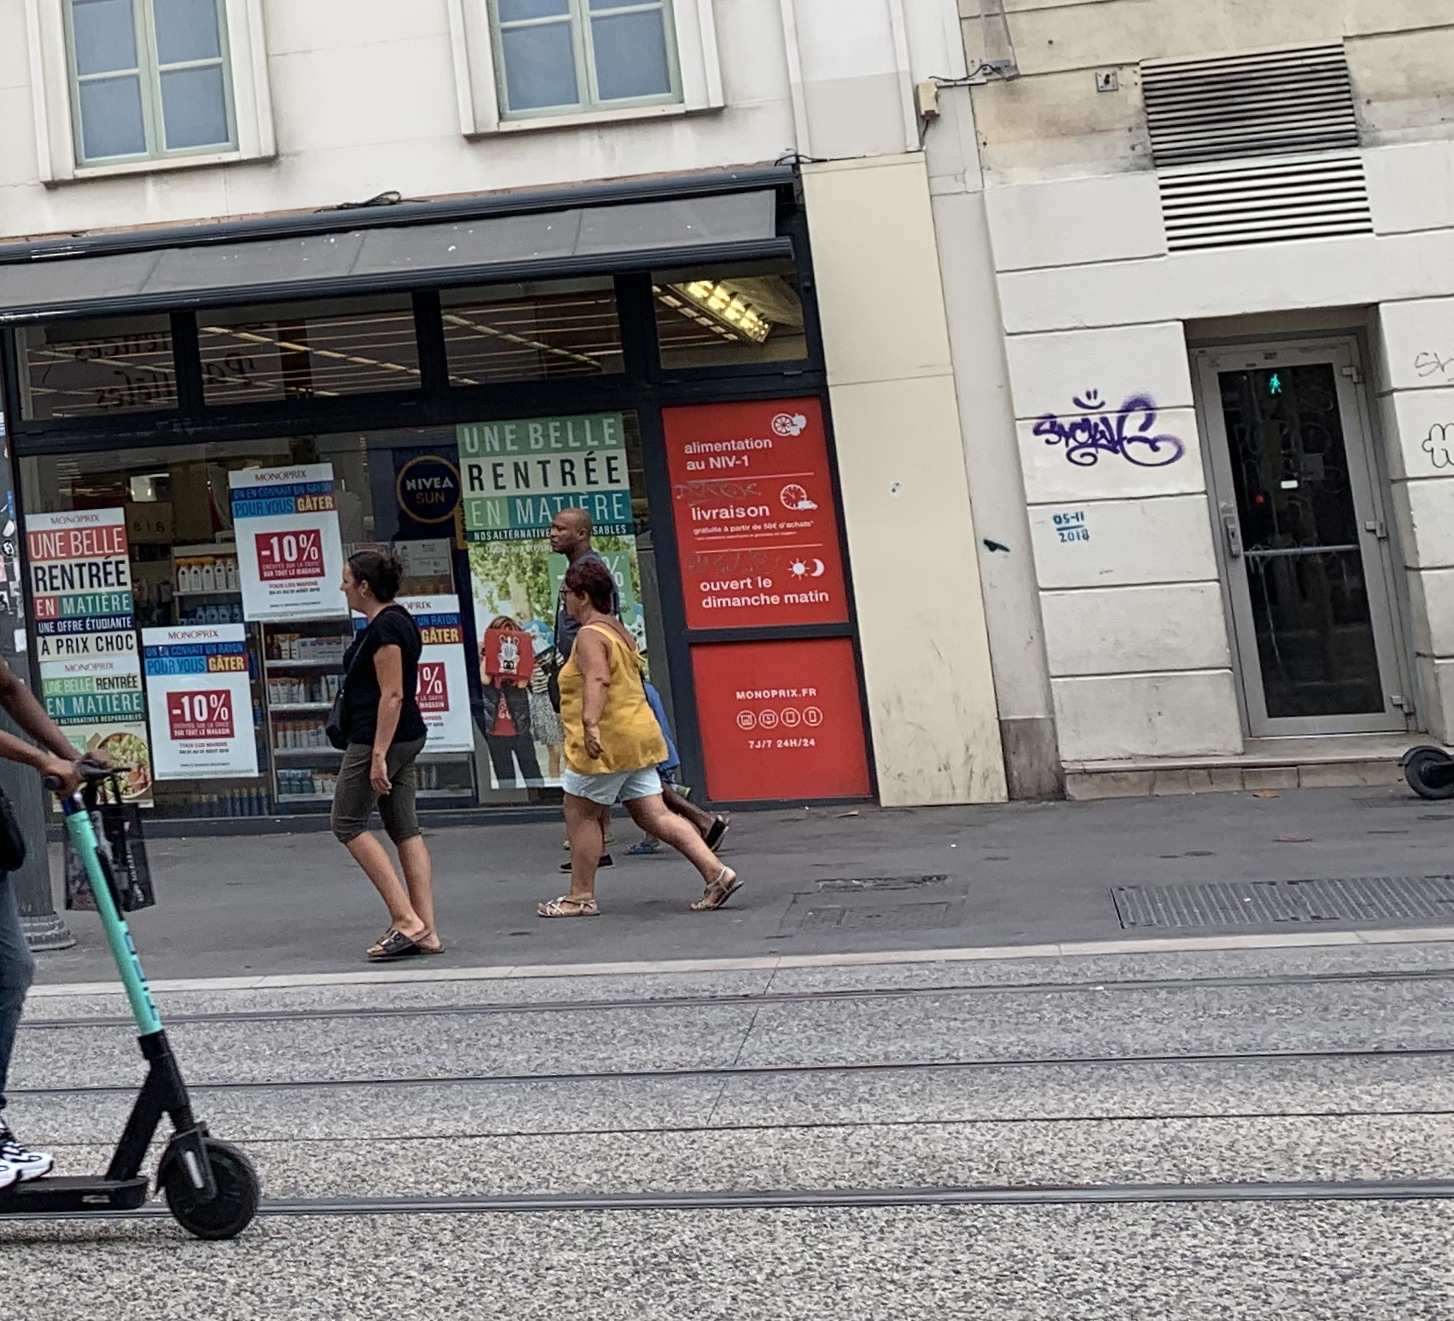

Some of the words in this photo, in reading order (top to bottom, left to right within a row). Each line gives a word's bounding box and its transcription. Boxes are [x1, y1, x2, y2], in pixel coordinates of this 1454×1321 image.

[464, 424, 519, 453] UNE
[528, 418, 617, 450] BELLE
[684, 438, 772, 454] alimentation
[467, 451, 622, 492] RENTRÉE
[686, 461, 705, 471] au
[709, 456, 749, 469] NIV-1
[255, 470, 307, 481] MONOPRIX
[406, 477, 453, 491] NIVEA
[235, 501, 263, 516] POUR
[265, 499, 294, 514] VOUS
[297, 495, 333, 511] GÂTER
[416, 491, 446, 504] SUN
[51, 514, 100, 525] MONOPRIX
[471, 499, 507, 527] EN
[692, 504, 770, 521] livraison
[474, 530, 492, 541] NOS
[493, 527, 551, 540] ALTERNATIVE
[30, 532, 66, 559] UNE
[70, 527, 125, 556] BELLE
[261, 533, 319, 563] -10%
[34, 555, 127, 592] RENTRÉE
[700, 579, 752, 591] ouvert
[757, 576, 772, 588] le
[36, 599, 55, 616] EN
[63, 592, 130, 615] MATIÈRE
[403, 601, 431, 610] OPRIX
[702, 593, 780, 608] dimanche
[784, 590, 829, 603] matin
[38, 621, 55, 633] UNE
[57, 620, 83, 632] OFFRE
[86, 617, 132, 631] ÉTUDIANTE
[168, 630, 219, 640] MONOPRIX
[422, 627, 459, 643] GÂTER
[41, 635, 50, 655] À
[56, 637, 90, 654] PRIX
[97, 634, 134, 652] CHOC
[65, 662, 114, 672] MONOPRIX
[147, 659, 175, 674] POUR
[179, 658, 205, 672] VOUS
[208, 655, 244, 671] GÂTER
[67, 679, 92, 693] BELLE
[96, 674, 138, 691] RENTRÉE
[736, 688, 817, 700] MONOPRIX.FR
[47, 698, 65, 715] EN
[73, 692, 141, 714] MATIÈRE
[172, 693, 228, 722] -10%
[749, 740, 772, 749] 7J/7
[777, 738, 816, 748] 24H/24
